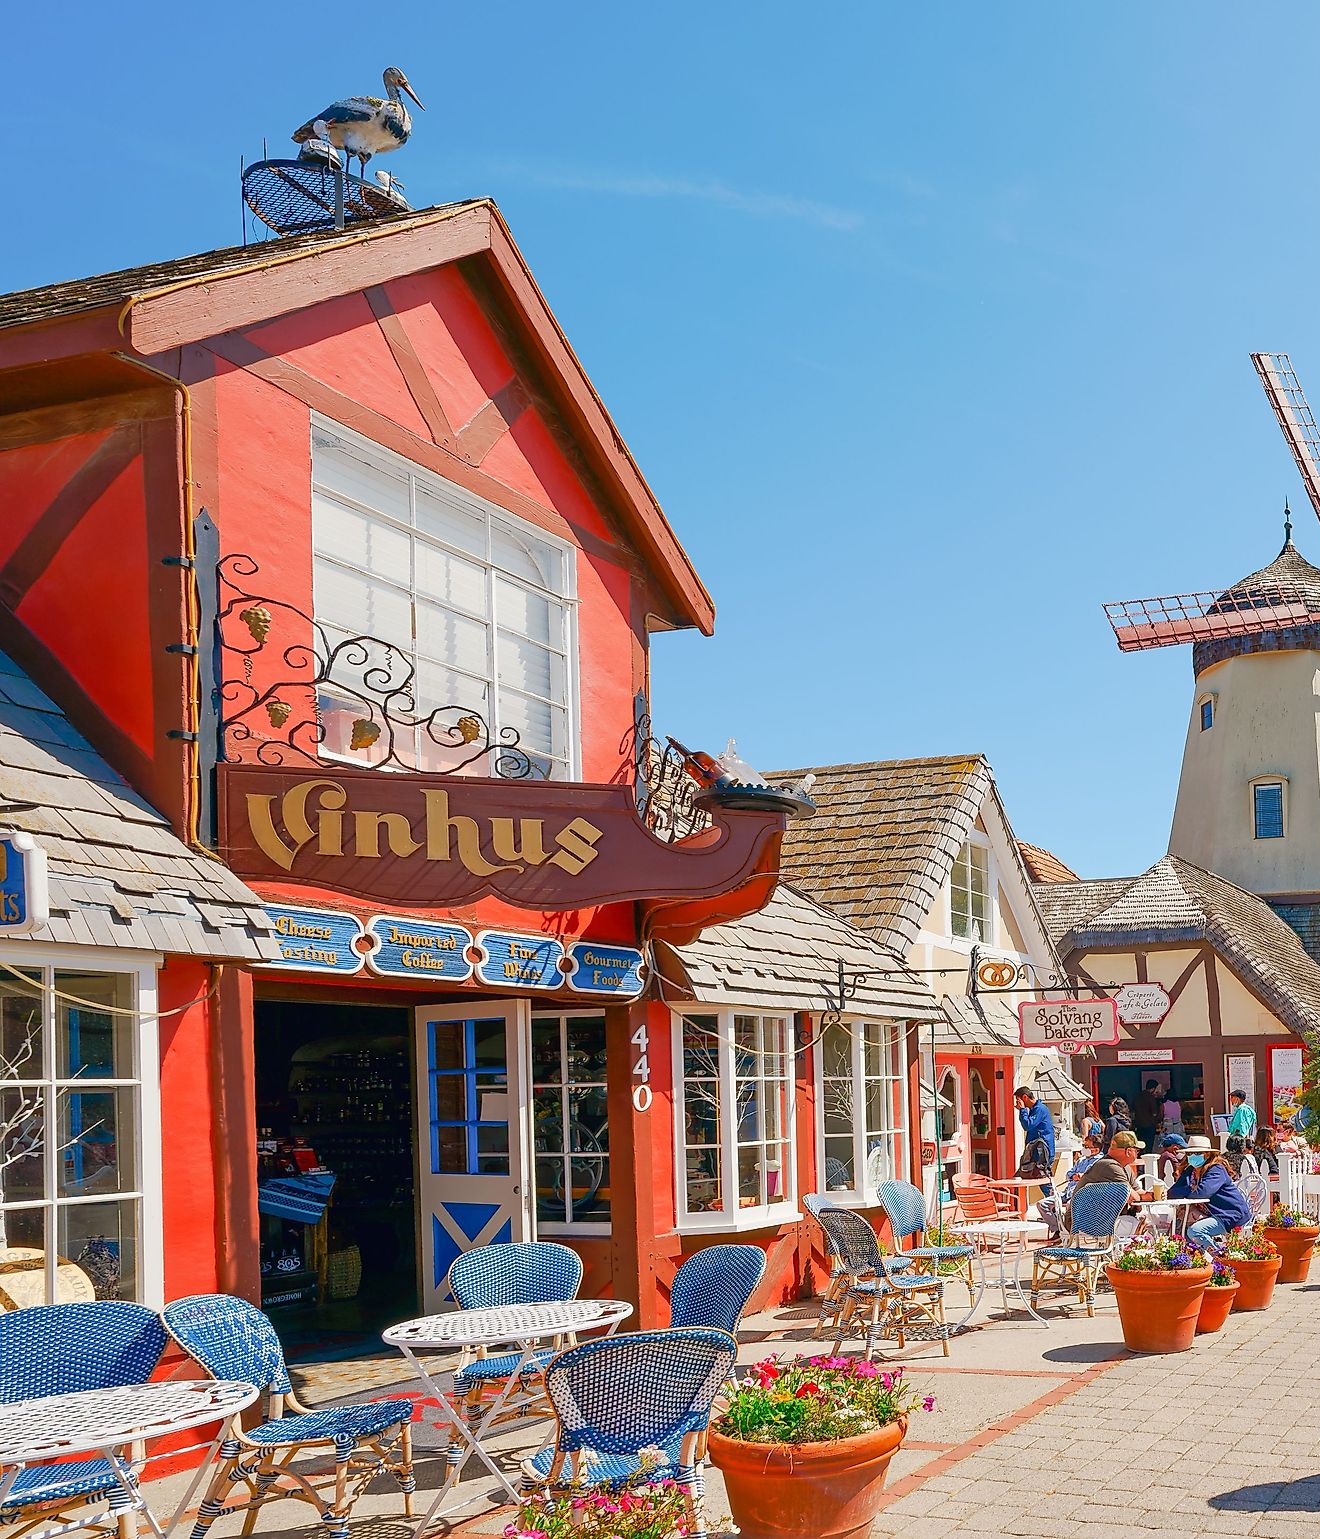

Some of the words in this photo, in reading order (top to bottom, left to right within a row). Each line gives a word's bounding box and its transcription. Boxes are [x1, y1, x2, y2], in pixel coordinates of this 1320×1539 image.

[246, 780, 603, 876] Vinhus
[276, 915, 331, 939] Cheese
[389, 927, 457, 949] Imported
[278, 940, 337, 965] asting
[402, 950, 444, 970] Coffee
[509, 942, 538, 960] Fine
[584, 951, 631, 969] Gourmet
[503, 962, 543, 980] Wines
[593, 971, 623, 987] Foods
[1061, 1005, 1077, 1013] The
[1141, 998, 1168, 1009] Gelato
[1035, 1008, 1103, 1029] Solvang
[1044, 1026, 1096, 1040] Bakery
[631, 1024, 653, 1112] 440
[277, 1257, 300, 1270] 805
